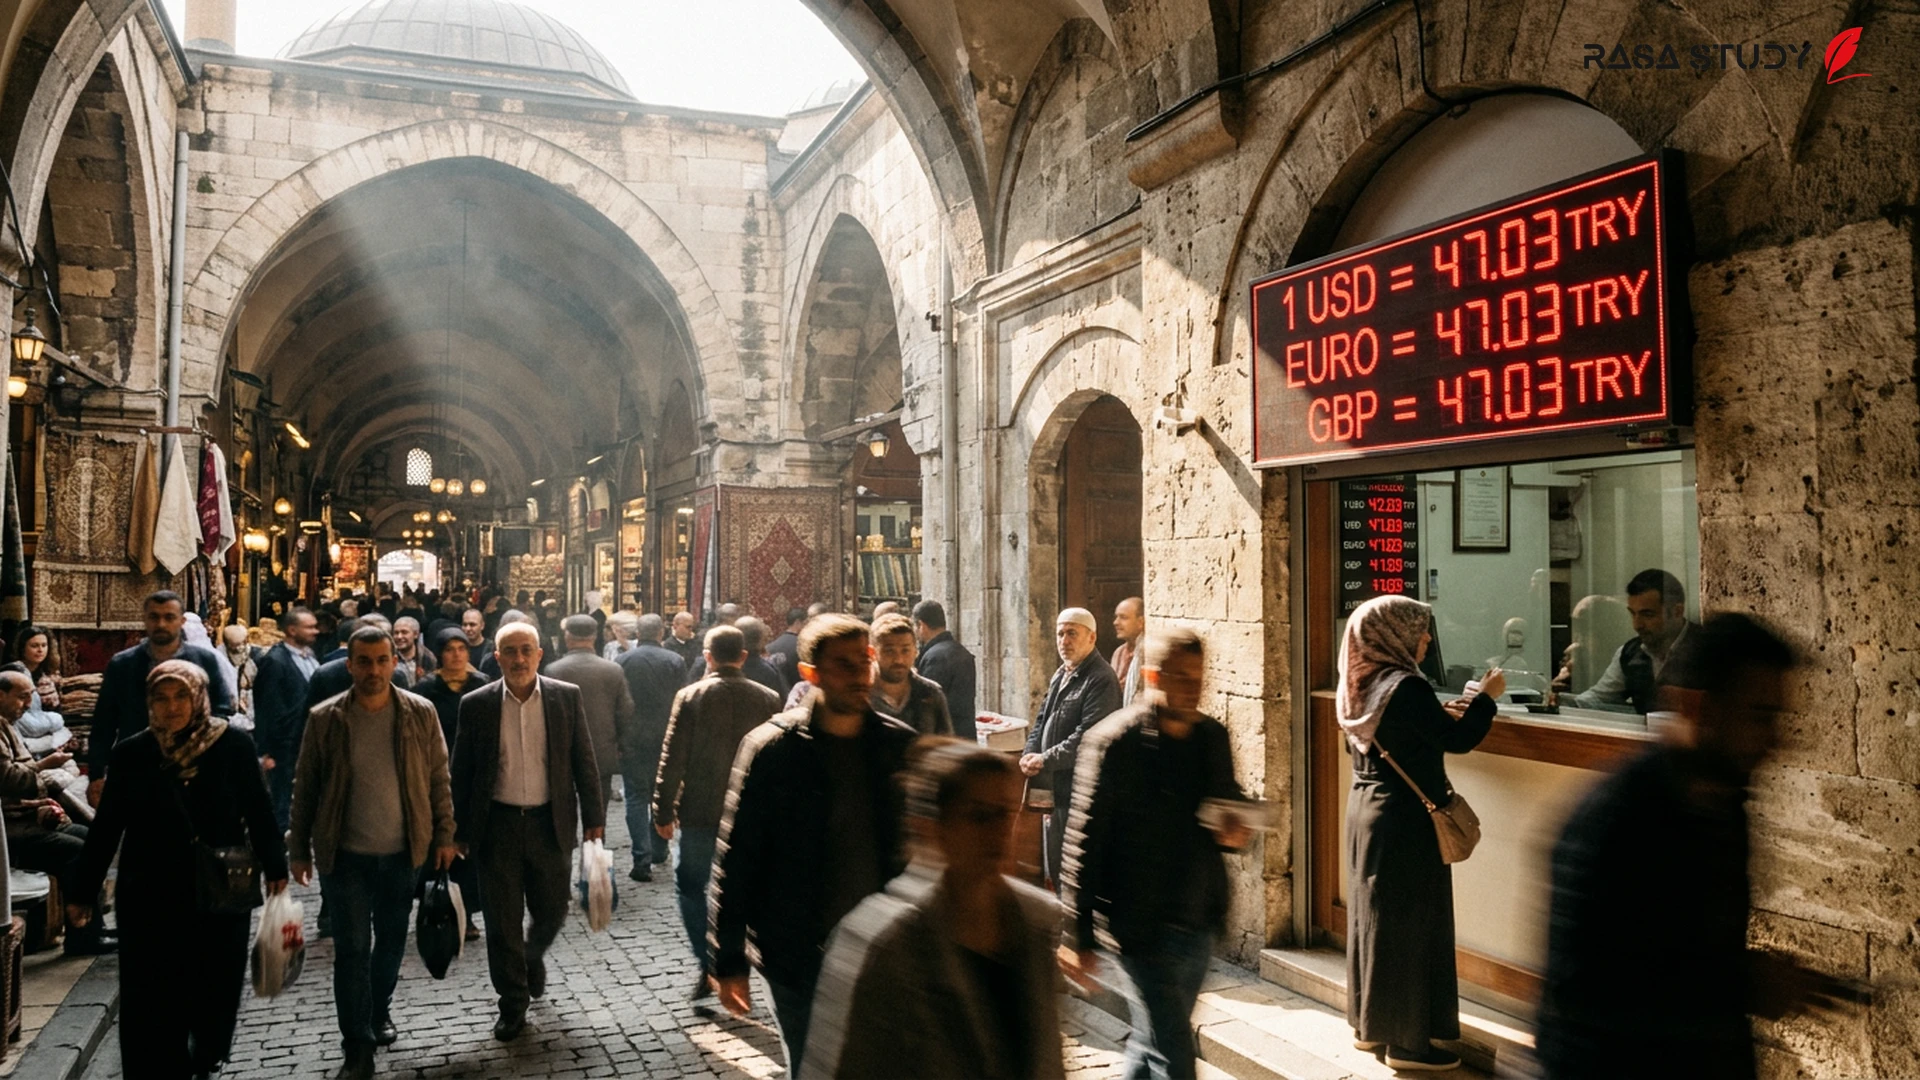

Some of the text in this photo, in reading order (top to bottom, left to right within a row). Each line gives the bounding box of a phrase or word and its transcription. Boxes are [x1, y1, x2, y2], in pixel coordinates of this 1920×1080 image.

[1282, 190, 1647, 331] 1 USD = 47.03 TRY
[1285, 269, 1650, 389] EURO = 47.03 TRY
[1308, 350, 1652, 444] GBP = 47.03 TRY
